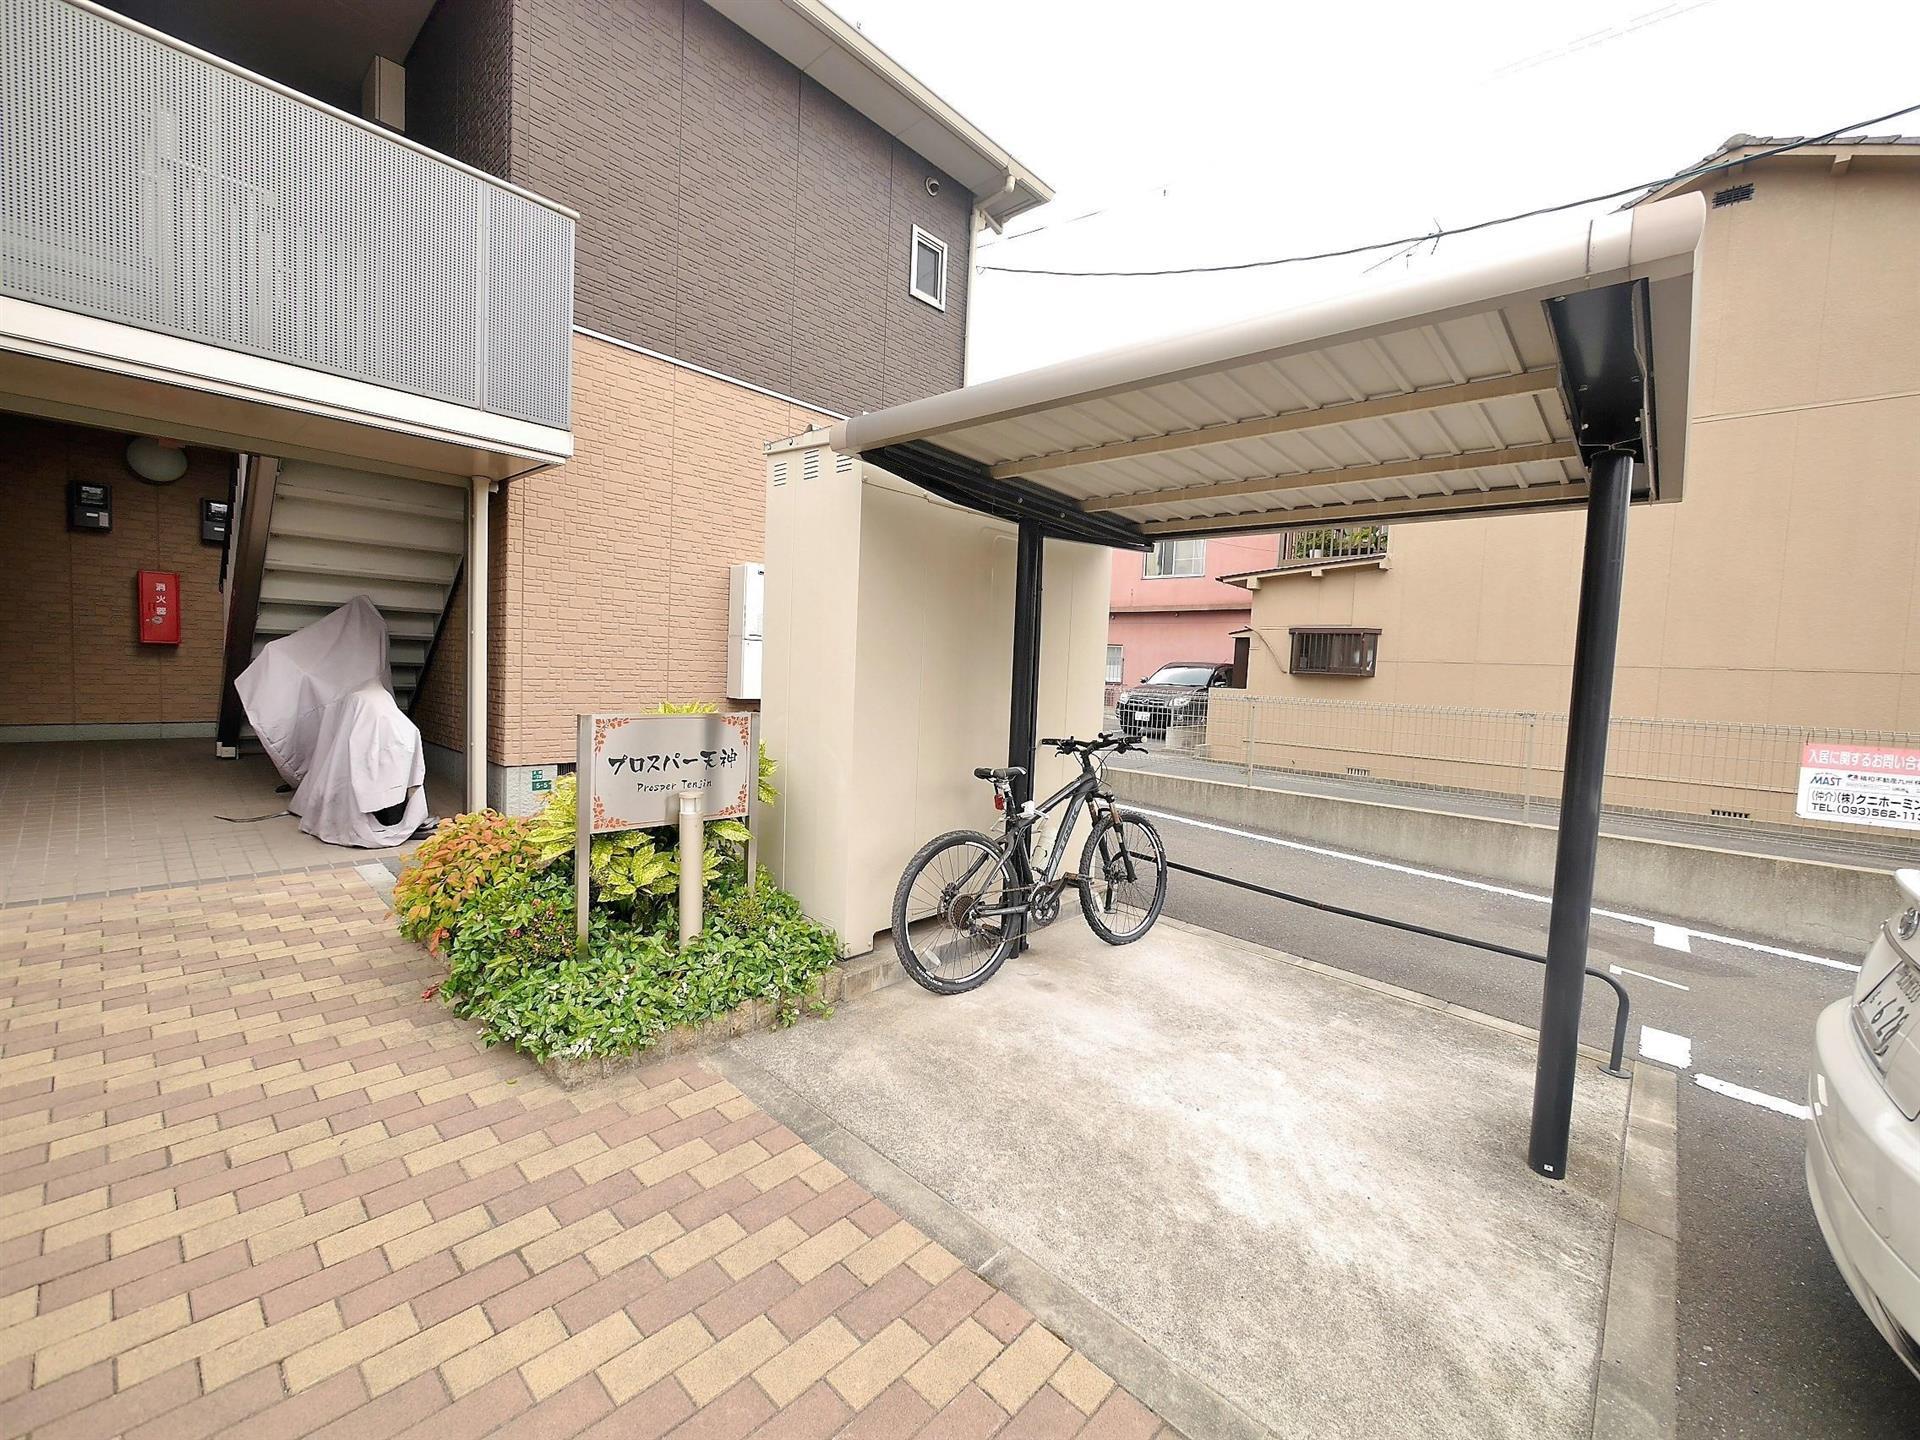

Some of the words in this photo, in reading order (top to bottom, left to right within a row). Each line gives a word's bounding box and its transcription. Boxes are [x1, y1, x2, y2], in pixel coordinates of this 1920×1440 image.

[154, 582, 167, 616] 消火器
[608, 748, 738, 776] プロスパー天神
[1808, 749, 1920, 770] 入居に関するお問い合
[637, 782, 677, 793] Prosper
[681, 778, 712, 791] Tenjin
[1810, 776, 1842, 787] MAST
